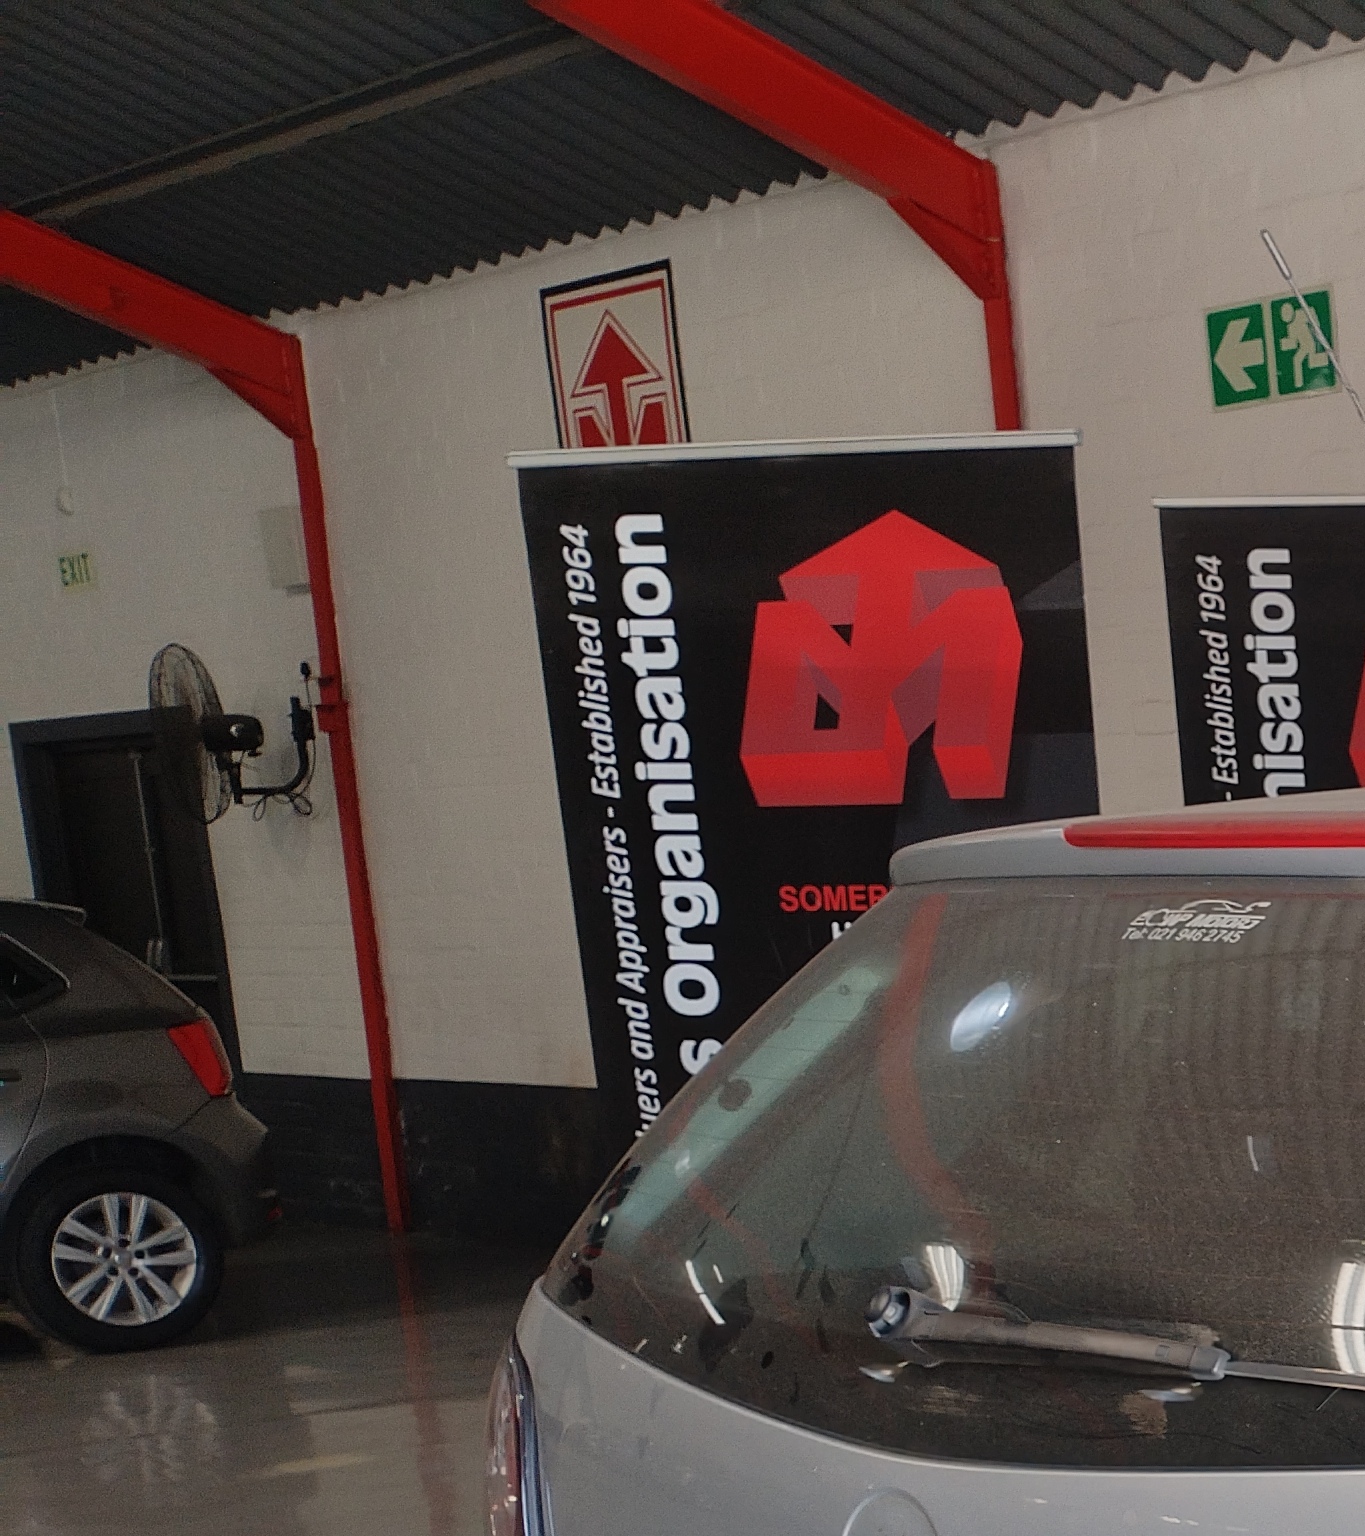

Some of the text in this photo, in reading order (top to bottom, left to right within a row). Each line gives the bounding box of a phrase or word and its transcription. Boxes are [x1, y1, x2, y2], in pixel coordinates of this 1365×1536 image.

[58, 552, 91, 587] EXIT
[559, 523, 597, 605] 1964
[1195, 554, 1227, 621] 1964
[567, 613, 621, 799] Established
[1199, 630, 1239, 785] Established
[614, 513, 721, 1017] Organisation
[602, 826, 650, 994] Appraisers
[778, 884, 896, 912] SOMER
[1147, 927, 1177, 940] 021
[1175, 928, 1206, 942] 946
[1202, 929, 1245, 943] 2745
[617, 998, 655, 1061] and
